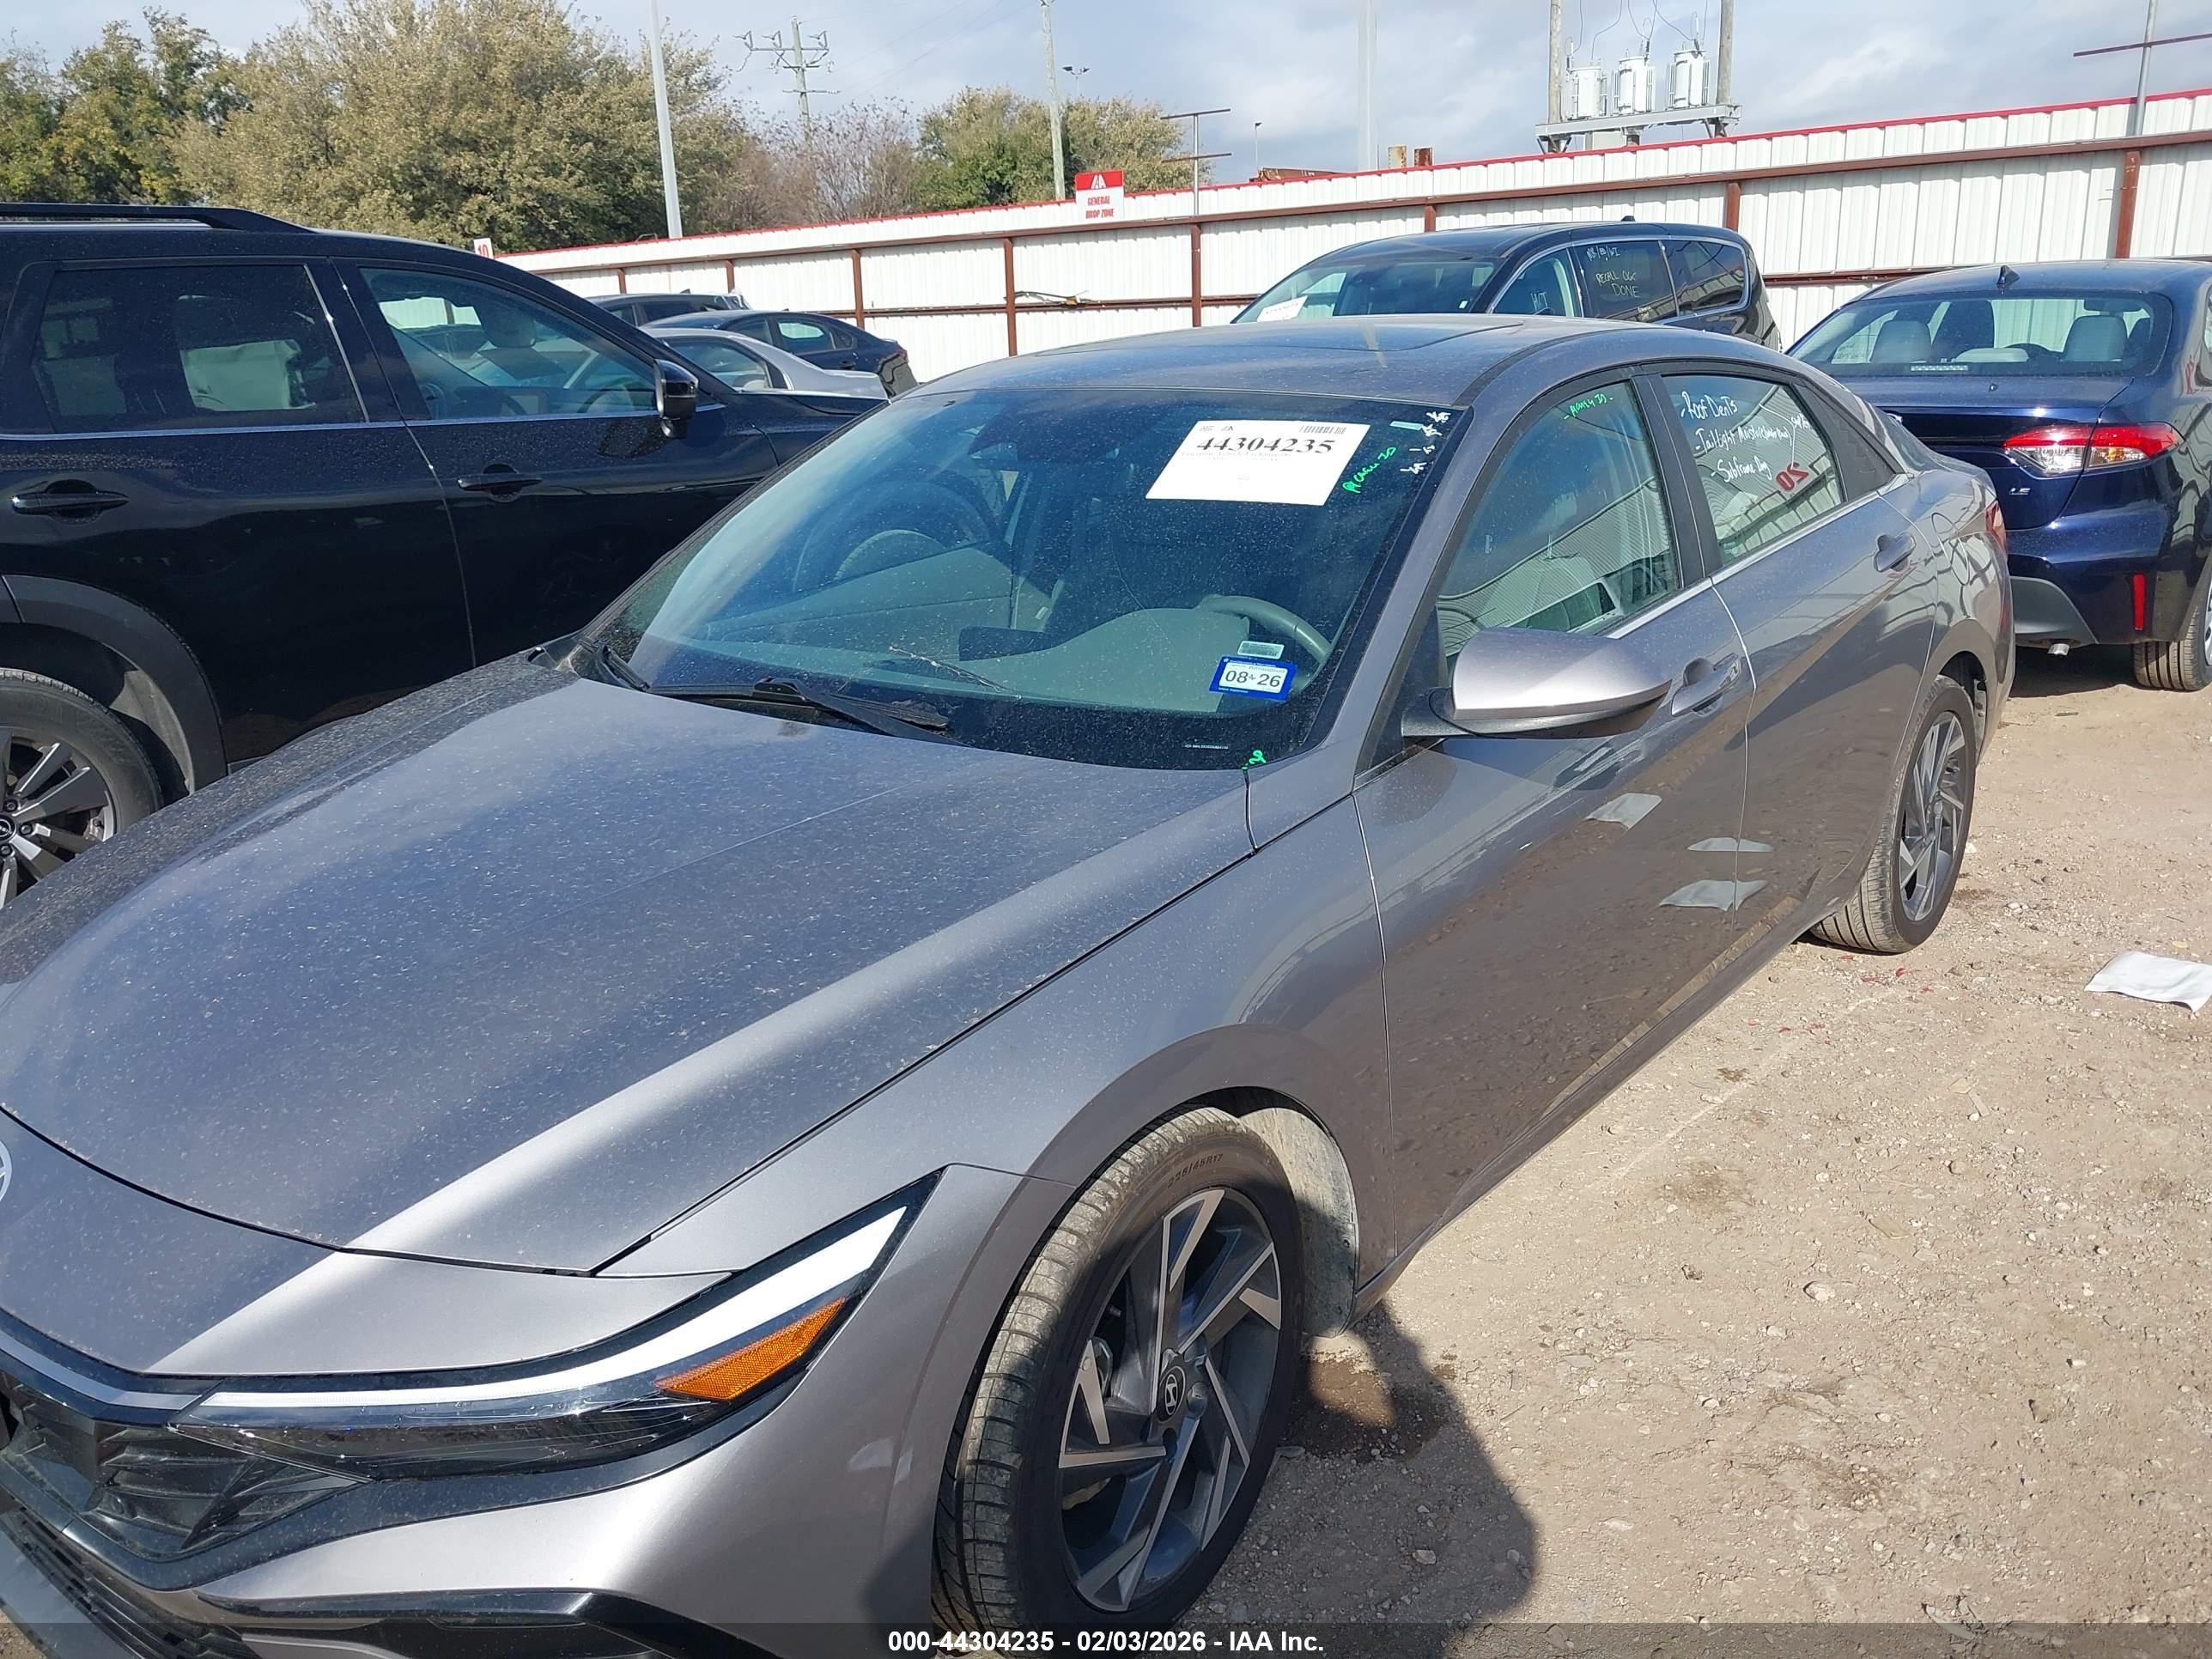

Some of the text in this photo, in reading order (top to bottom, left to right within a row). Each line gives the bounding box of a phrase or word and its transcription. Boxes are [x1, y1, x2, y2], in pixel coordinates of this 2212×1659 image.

[1087, 196, 1110, 206] GENERAL
[1085, 208, 1115, 220] DROP ZONE
[1611, 283, 1641, 298] DONE
[1196, 436, 1336, 453] 44304235
[2009, 487, 2031, 495] LE
[1225, 670, 1282, 688] 08 26
